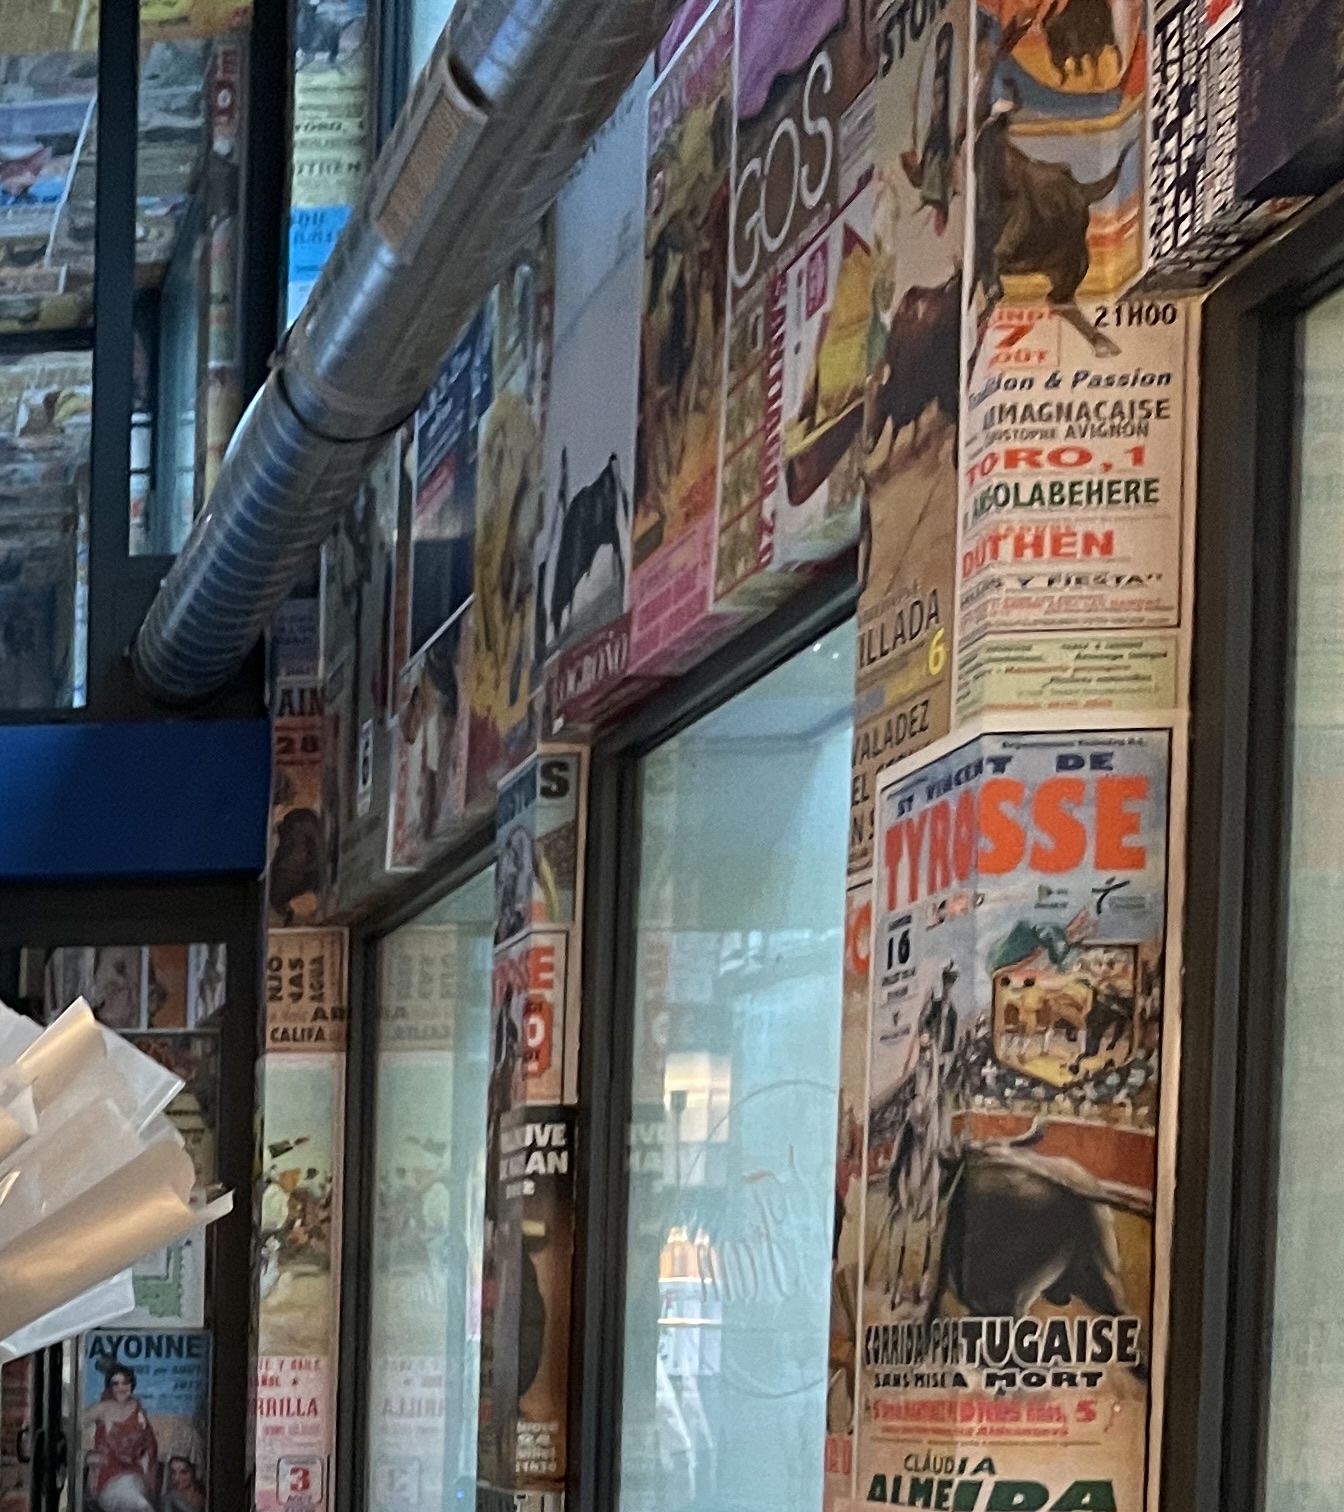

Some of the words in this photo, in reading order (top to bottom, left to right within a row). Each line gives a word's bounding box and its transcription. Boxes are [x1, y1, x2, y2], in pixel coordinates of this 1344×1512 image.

[1093, 303, 1177, 328] 21H00
[992, 323, 1035, 349] 7
[1071, 367, 1173, 390] Passion
[1063, 418, 1150, 441] AVIGNON
[927, 627, 948, 676] 6
[1055, 751, 1114, 773] DE
[883, 774, 1151, 912] TYROSSE
[886, 929, 912, 970] 16
[930, 1316, 1141, 1367] PORTUGAISE
[984, 1370, 1105, 1389] MORT
[289, 1466, 311, 1493] 3
